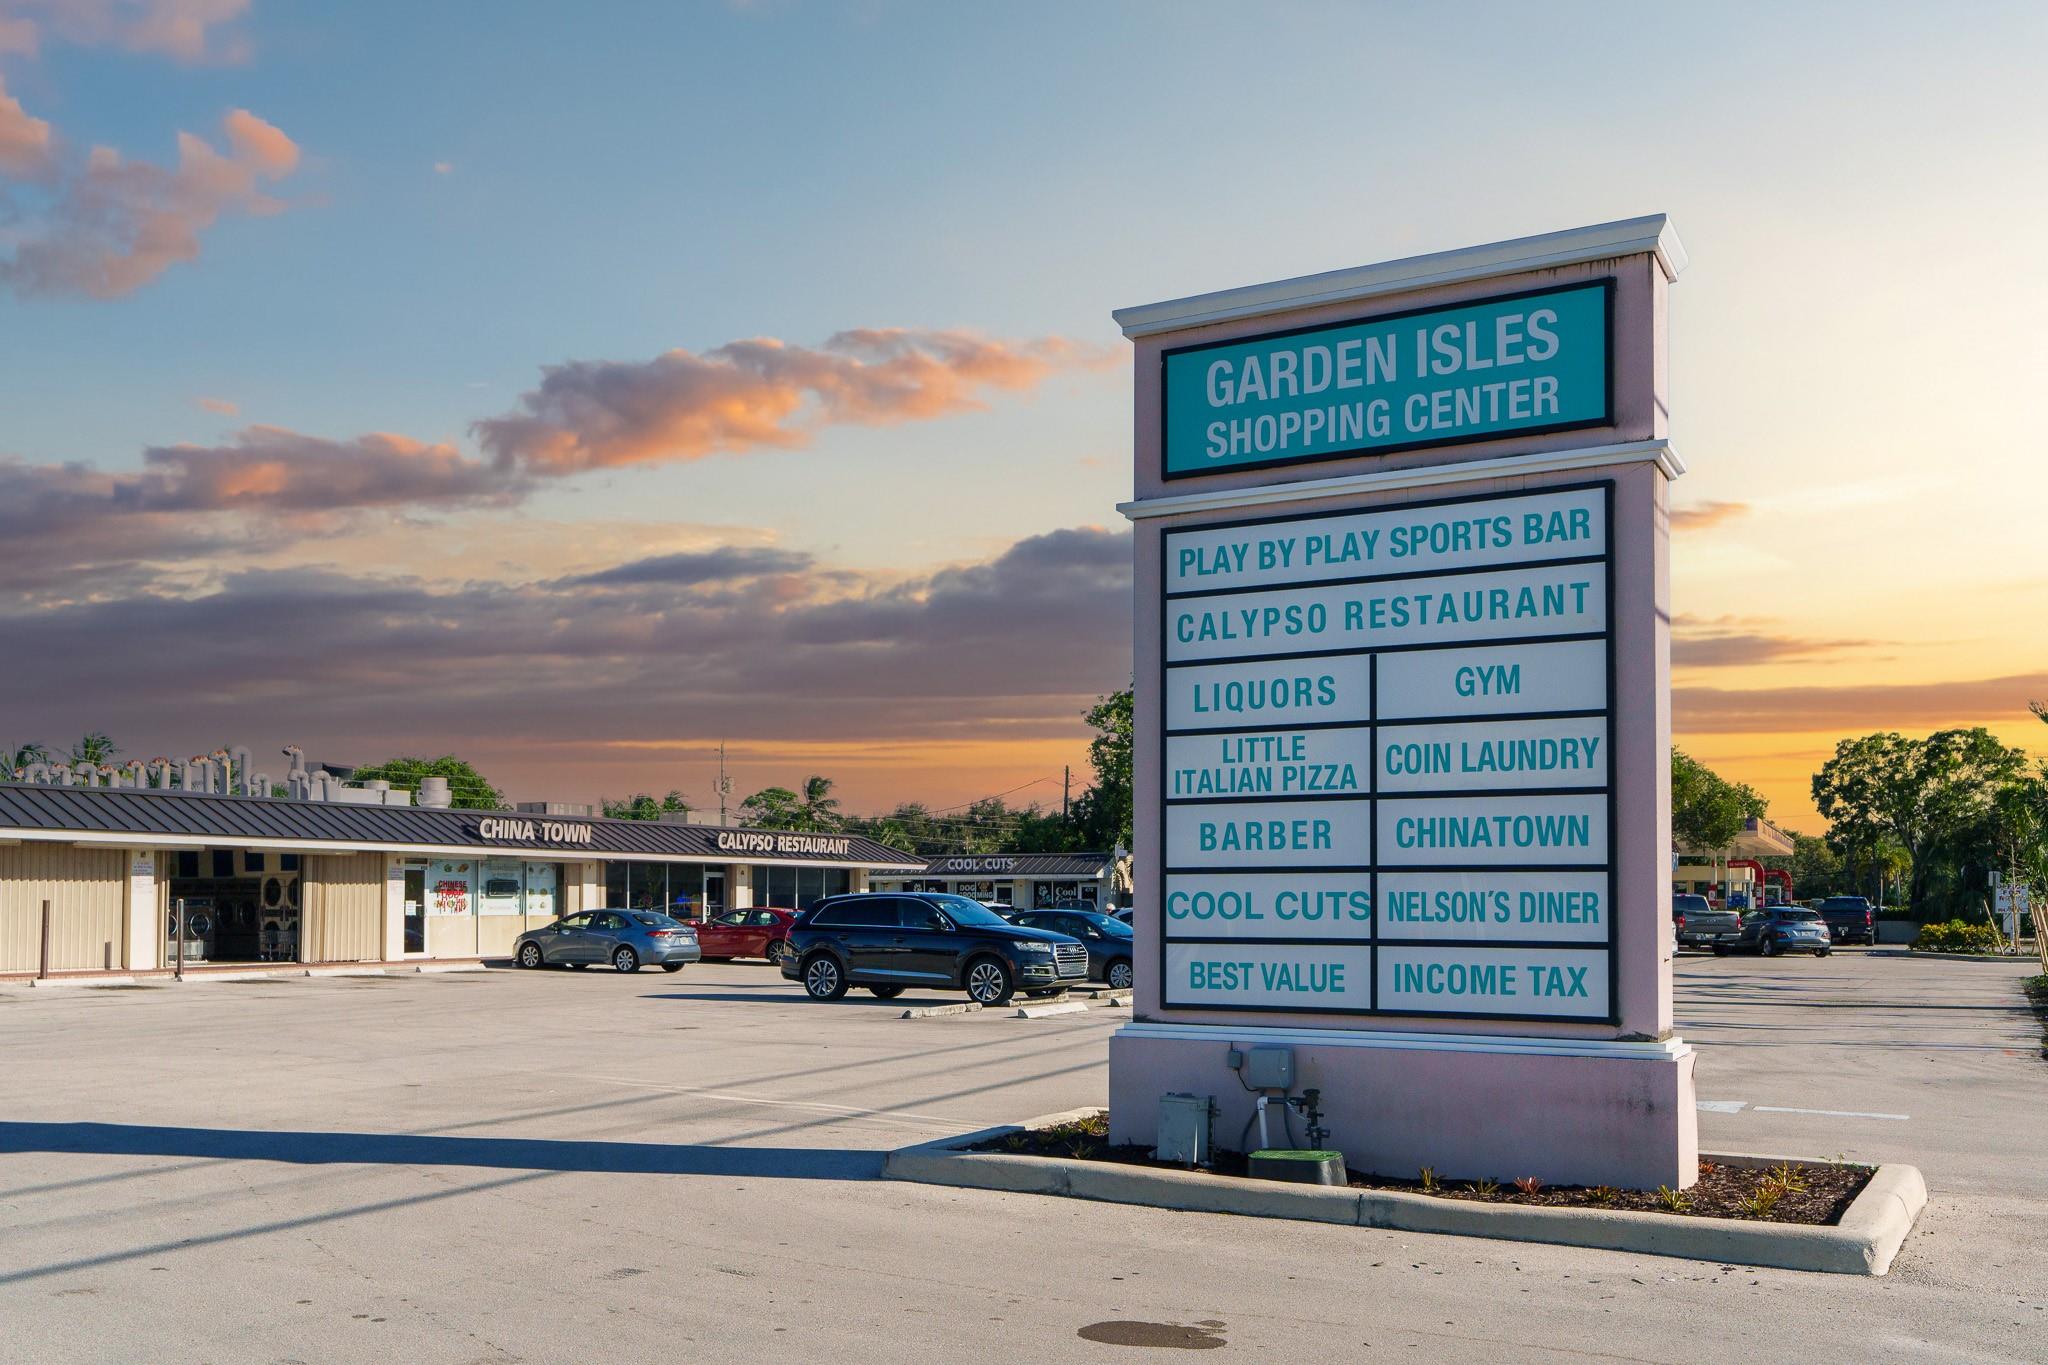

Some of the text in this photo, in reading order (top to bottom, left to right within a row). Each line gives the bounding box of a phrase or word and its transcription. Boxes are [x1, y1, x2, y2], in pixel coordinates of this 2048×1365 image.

[1206, 308, 1559, 407] GARDEN ISLES
[1206, 375, 1559, 458] SHOPPING CENTER
[1179, 508, 1591, 577] PLAY BY PLAY SPORTS BAR
[1177, 582, 1590, 643] CALYPSO RESTAURANT
[1194, 675, 1336, 713] LIQUORS
[1455, 664, 1521, 697] GYM
[1222, 735, 1306, 763] LITTLE
[1385, 737, 1600, 775] COIN LAUNDRY
[1174, 763, 1358, 794] ITALIAN PIZZA
[480, 818, 592, 843] CHINA TOWN
[718, 832, 850, 855] CALYPSO RESTAURANT
[1199, 819, 1332, 852] BARBER
[1396, 814, 1589, 849] CHINATOWN
[947, 858, 1014, 870] COOL CUTS
[438, 880, 467, 888] CHINESE
[959, 884, 975, 892] DOG
[1055, 887, 1077, 896] Cool
[1167, 891, 1370, 920] COOL CUTS
[1388, 890, 1600, 924] NELSON'S DINER
[1189, 962, 1346, 992] BEST VALUE
[1394, 963, 1589, 998] INCOME TAX
